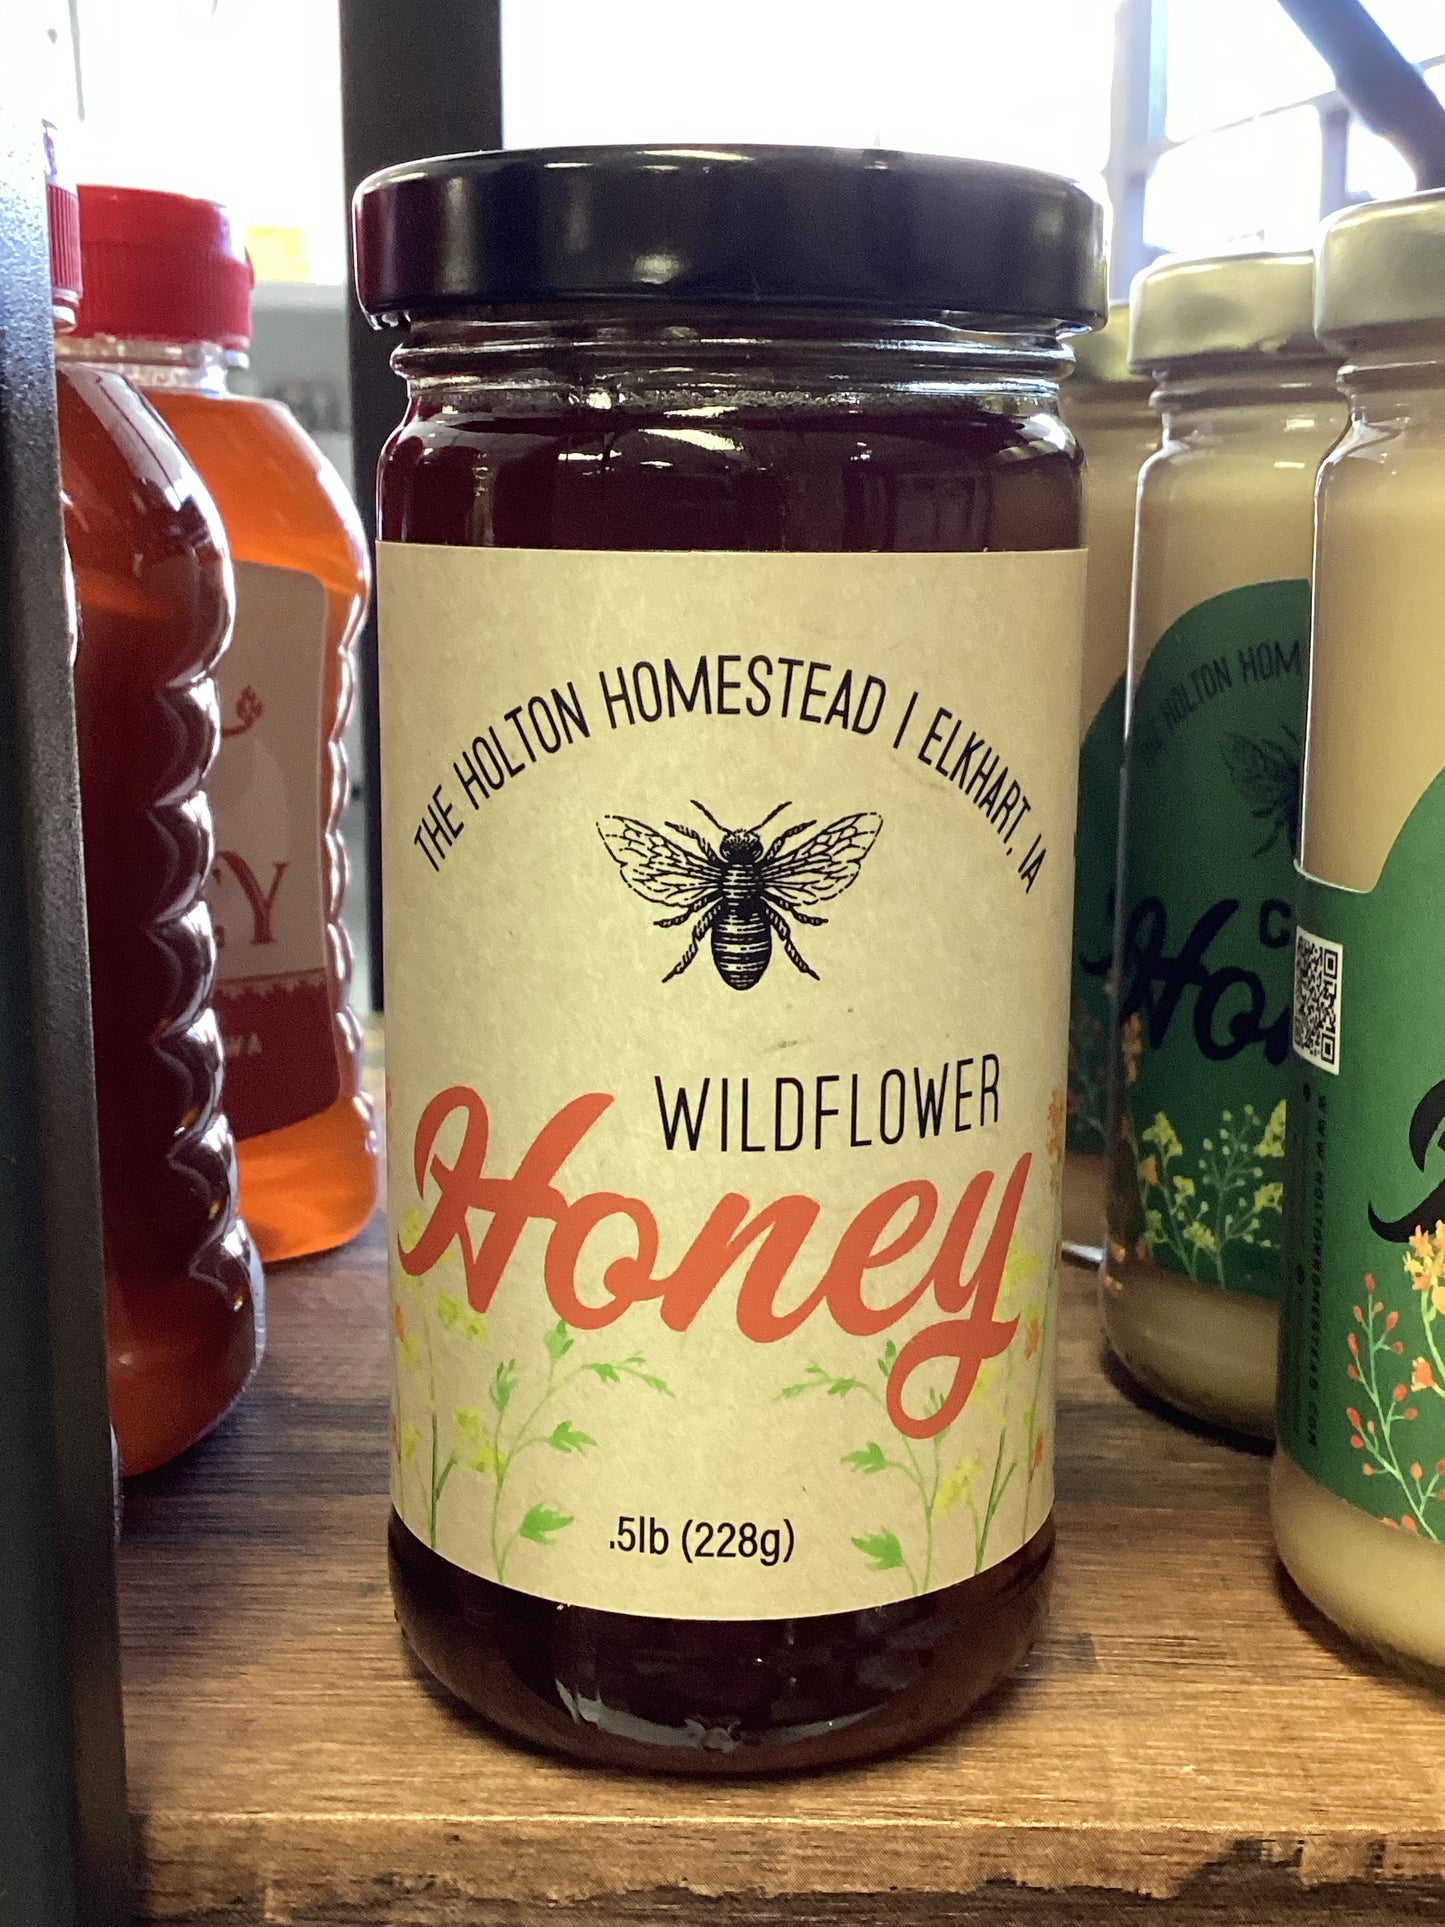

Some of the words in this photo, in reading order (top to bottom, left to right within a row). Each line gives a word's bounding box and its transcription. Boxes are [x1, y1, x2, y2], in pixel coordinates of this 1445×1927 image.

[1238, 640, 1302, 683] HOM
[413, 784, 465, 873] THE
[452, 681, 591, 811] HOLTON
[599, 654, 888, 735] HOMESTEAD
[917, 706, 1032, 856] ELKHART,
[1017, 833, 1047, 895] IA
[654, 1053, 1000, 1153] WILDFLOWER
[397, 1085, 1033, 1439] Honey
[609, 1516, 669, 1555] .5lb
[681, 1518, 796, 1567] (228g)
